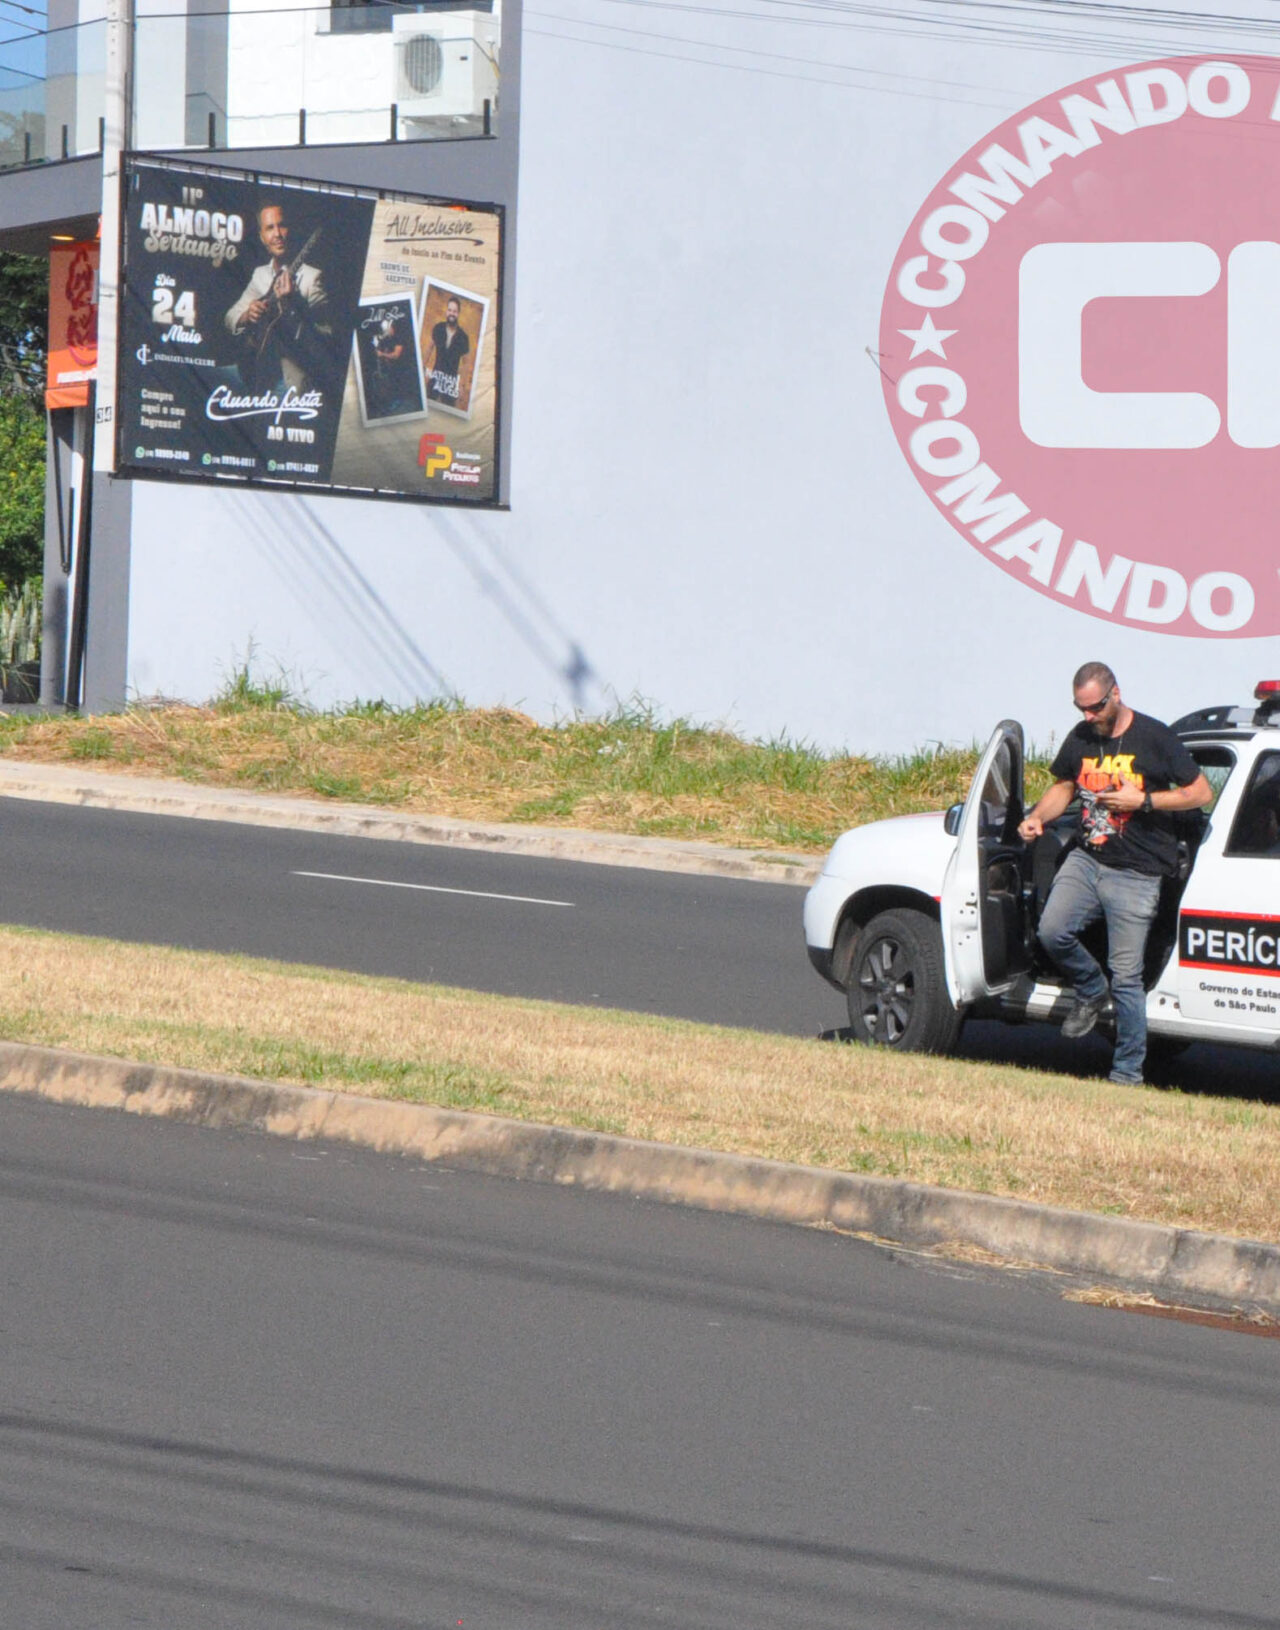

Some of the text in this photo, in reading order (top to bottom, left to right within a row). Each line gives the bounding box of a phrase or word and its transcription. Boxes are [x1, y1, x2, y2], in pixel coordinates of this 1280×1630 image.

[386, 214, 474, 237] All Inclusive
[144, 229, 238, 268] Sertanejo
[464, 253, 485, 265] Evento
[155, 273, 176, 287] Dia
[152, 288, 196, 327] 24
[161, 325, 203, 344] Maio
[141, 403, 185, 417] aqui o seu
[206, 384, 323, 424] Eduardo Costa
[267, 425, 315, 444] AO VIVO
[1080, 753, 1136, 774] BLACK
[1198, 981, 1239, 995] Governo
[1241, 986, 1254, 997] do
[1214, 998, 1277, 1014] de São Paulo
